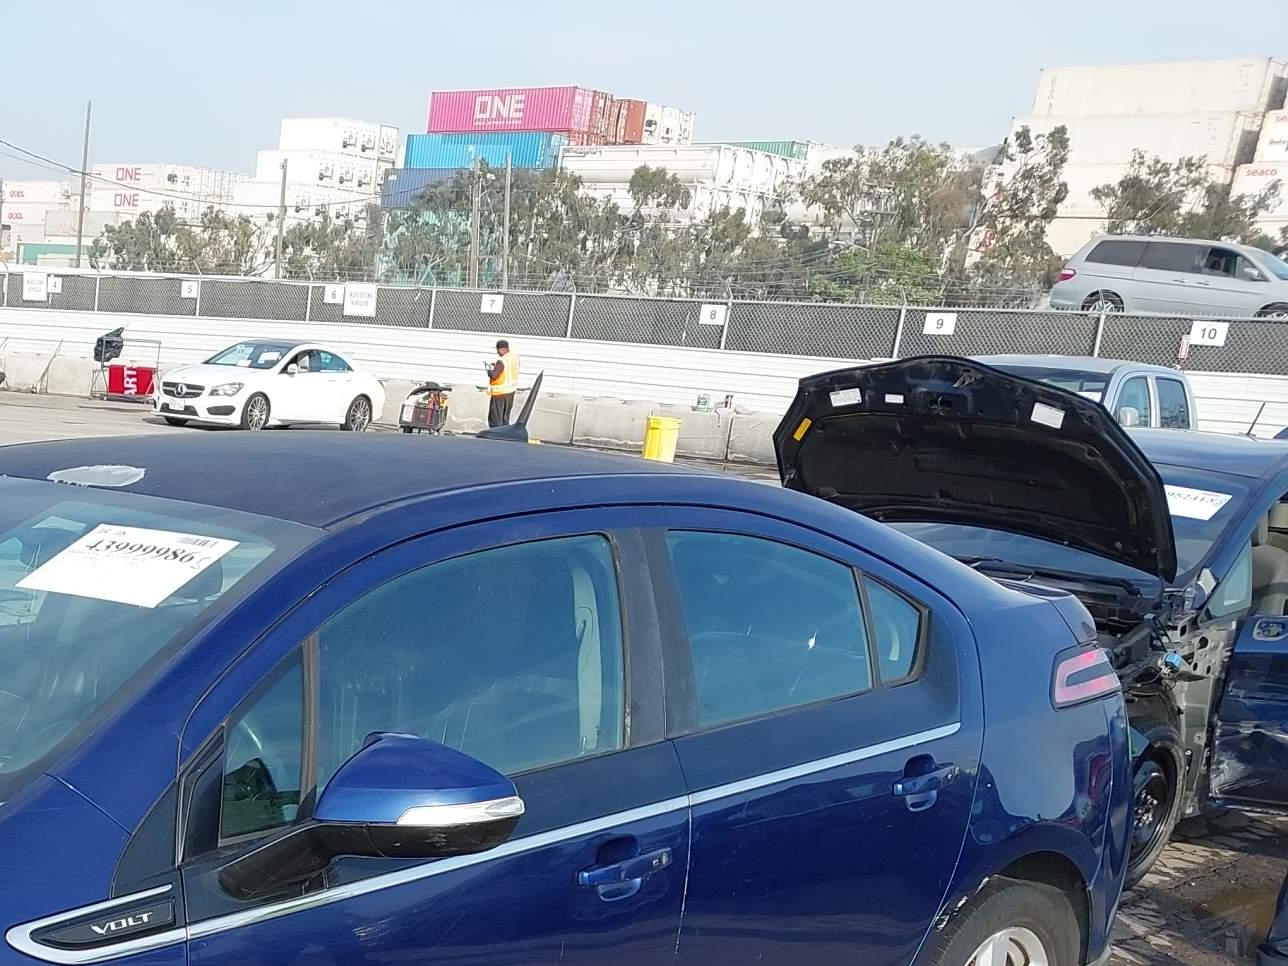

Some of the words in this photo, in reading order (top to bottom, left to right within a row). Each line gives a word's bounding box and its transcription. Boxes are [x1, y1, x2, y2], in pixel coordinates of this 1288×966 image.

[474, 94, 526, 119] ONE
[116, 167, 142, 181] ONE
[1245, 168, 1278, 177] seaco
[114, 193, 139, 207] ONE
[187, 285, 193, 294] 5
[331, 290, 337, 300] 6
[488, 299, 495, 309] 7
[709, 309, 717, 320] 8
[936, 318, 944, 330] 9
[1201, 327, 1217, 340] 10
[85, 538, 201, 564] 43999986
[90, 912, 153, 936] VOLT
